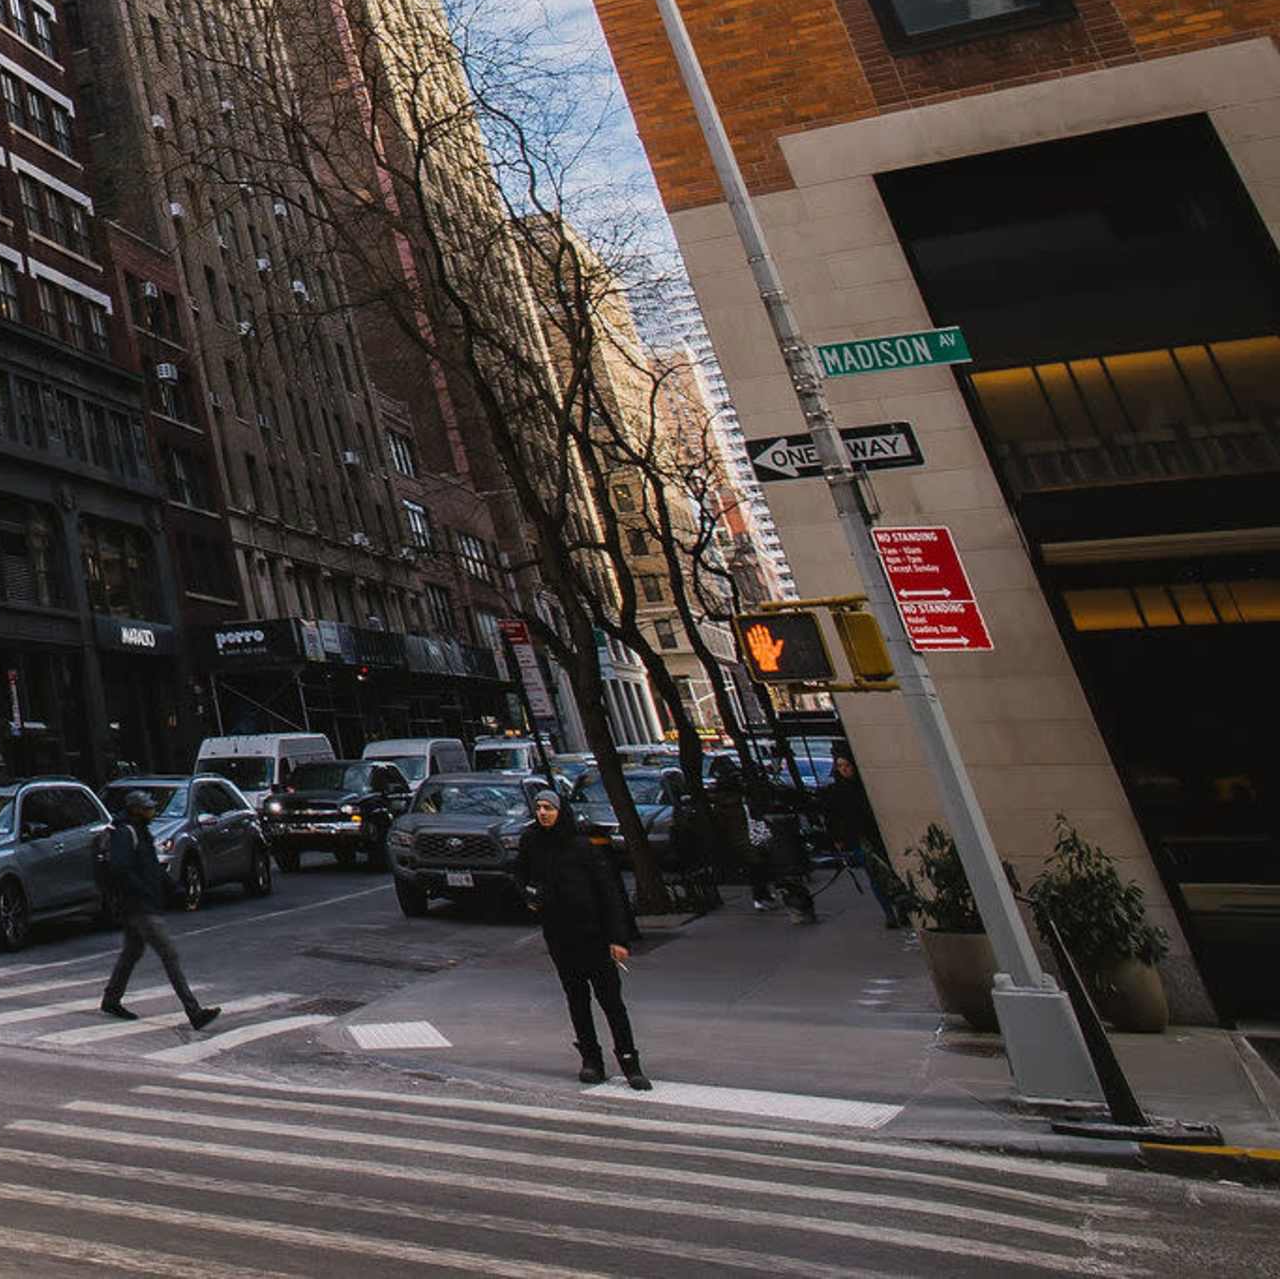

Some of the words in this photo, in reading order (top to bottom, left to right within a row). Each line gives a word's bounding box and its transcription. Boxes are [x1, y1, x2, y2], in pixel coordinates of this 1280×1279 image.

[822, 337, 933, 373] MADISON
[939, 333, 956, 348] AV
[771, 446, 817, 468] ONE
[846, 436, 900, 459] WAY
[877, 532, 891, 543] NO
[892, 532, 938, 543] STANDING
[903, 604, 917, 614] NO
[919, 603, 965, 614] STANDING
[216, 630, 265, 649] porro
